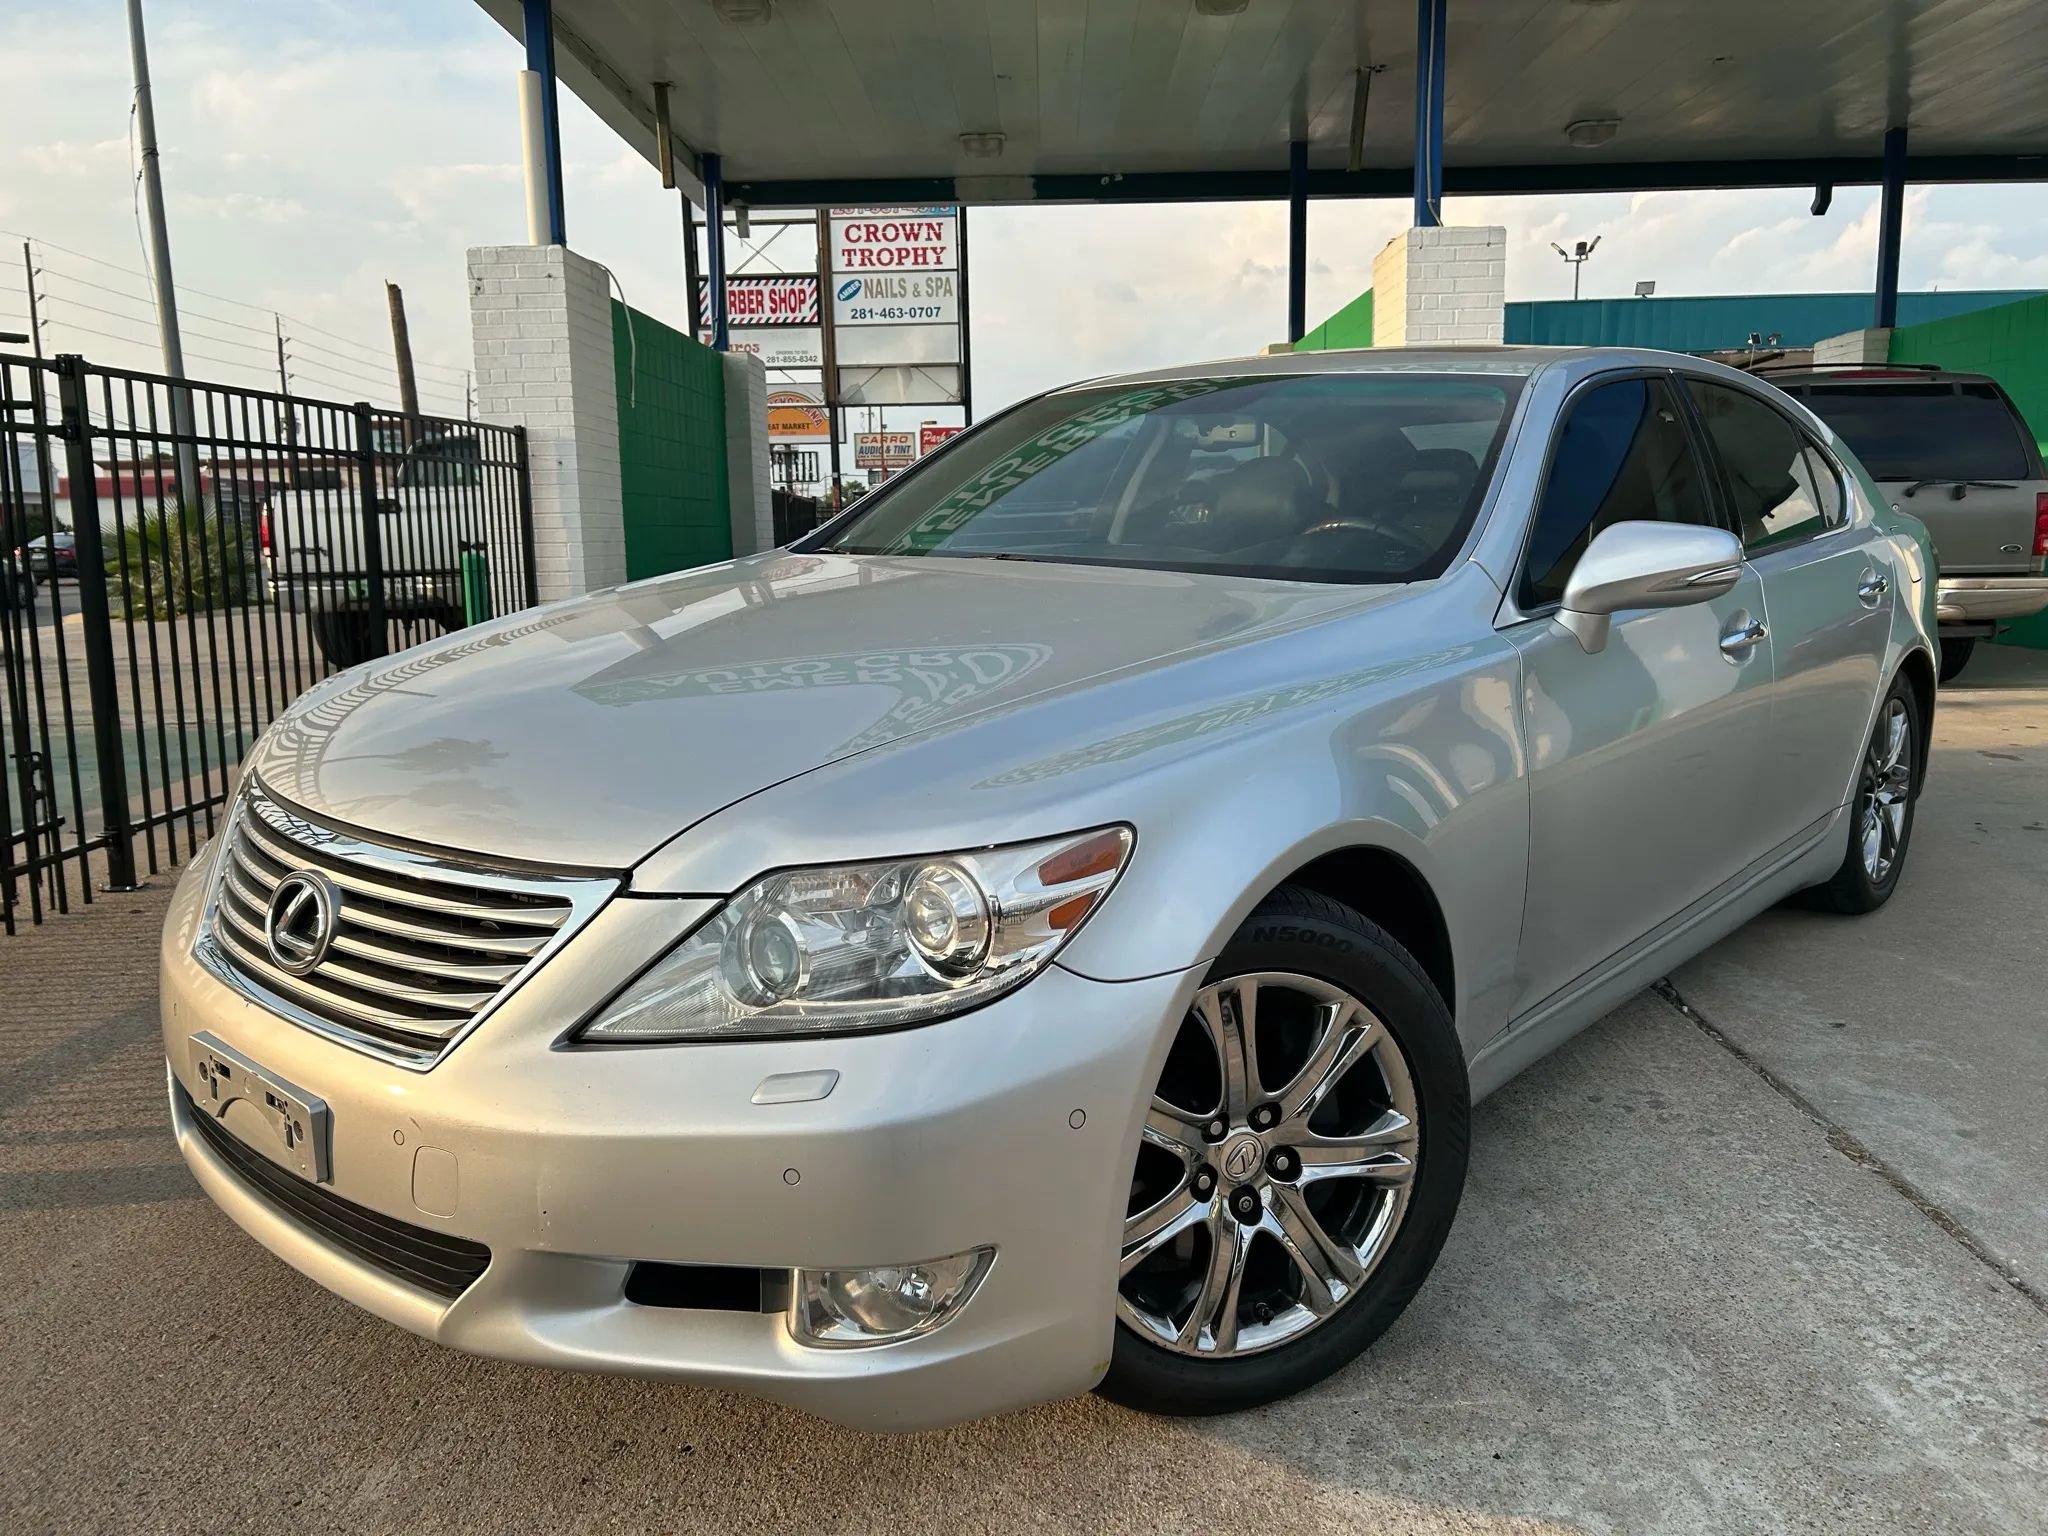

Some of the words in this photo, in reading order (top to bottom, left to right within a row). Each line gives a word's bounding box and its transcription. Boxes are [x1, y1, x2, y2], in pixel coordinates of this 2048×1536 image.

[844, 222, 944, 243] CROWN
[842, 246, 947, 267] TROPHY
[838, 280, 862, 300] AMBER
[864, 277, 907, 299] NAILS
[912, 282, 922, 298] &
[925, 276, 953, 298] SPA
[728, 289, 765, 315] RBER
[769, 287, 807, 314] SHOP
[850, 306, 941, 320] 281-463-0707
[782, 422, 810, 430] MARKET
[860, 435, 909, 444] CARRO
[885, 445, 892, 454] &
[893, 445, 911, 454] TINT
[1252, 925, 1354, 954] N5000
